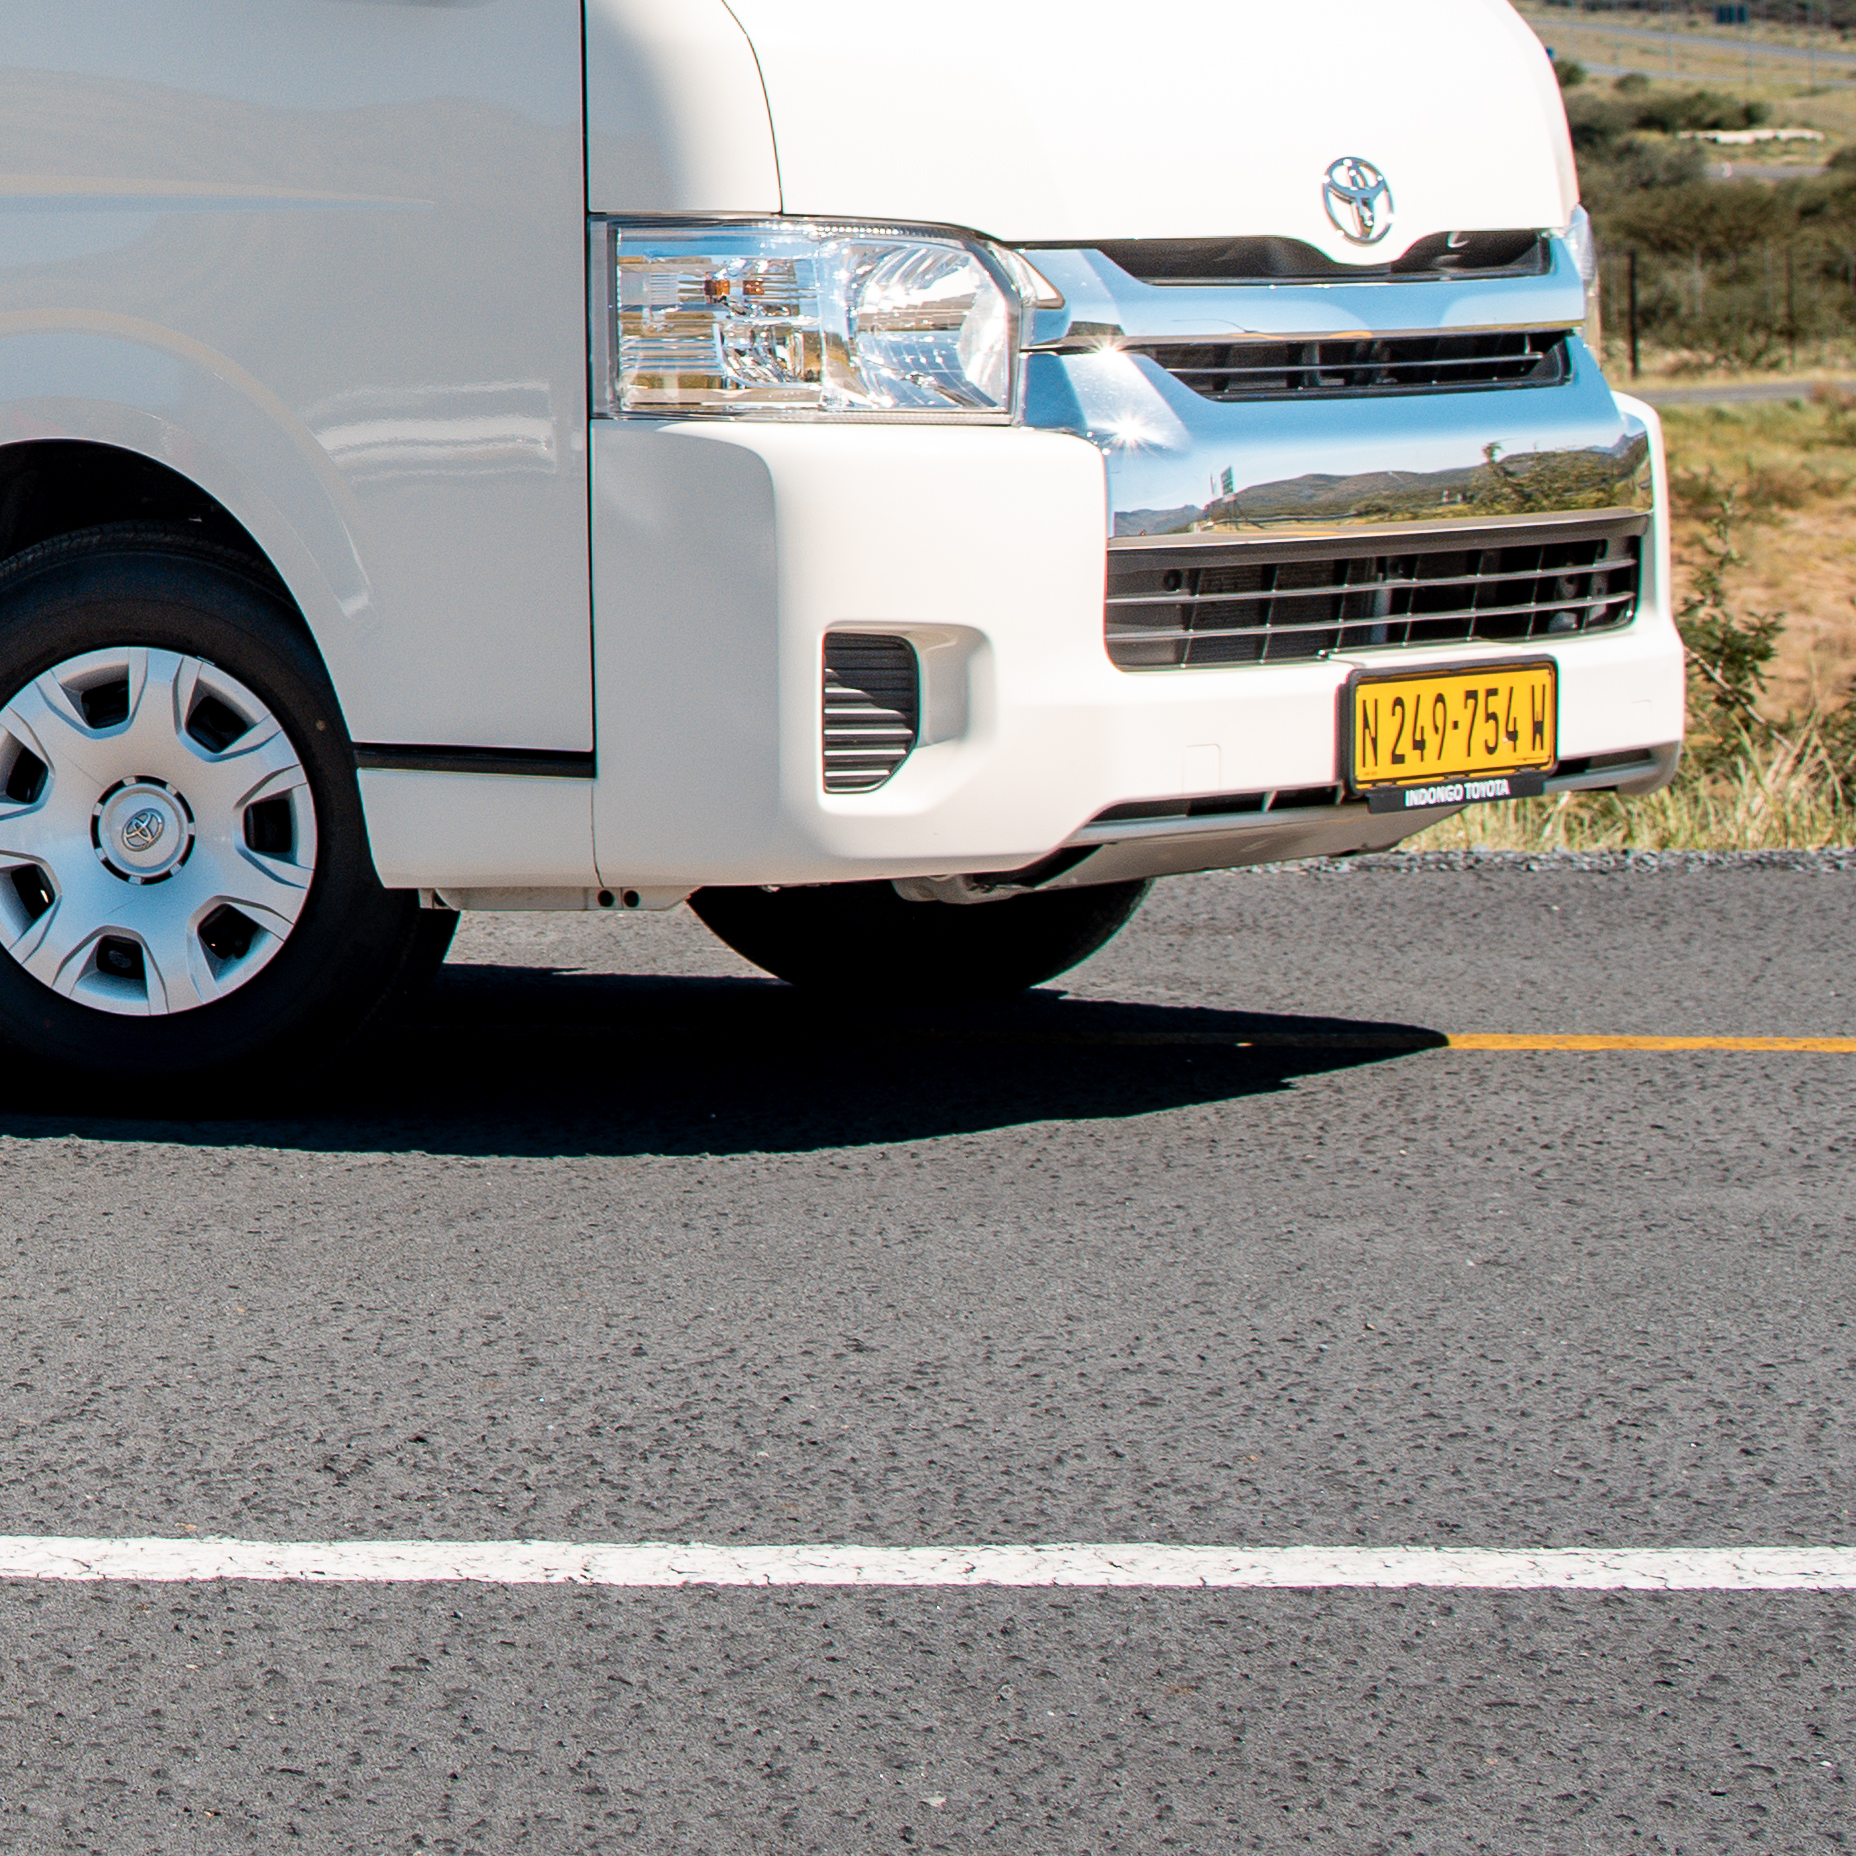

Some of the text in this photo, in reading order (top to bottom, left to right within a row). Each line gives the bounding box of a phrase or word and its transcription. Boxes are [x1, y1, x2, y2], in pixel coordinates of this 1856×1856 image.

[1361, 698, 1378, 768] N
[1531, 684, 1546, 752] W
[1405, 779, 1510, 807] INDONGO TOYOTA
